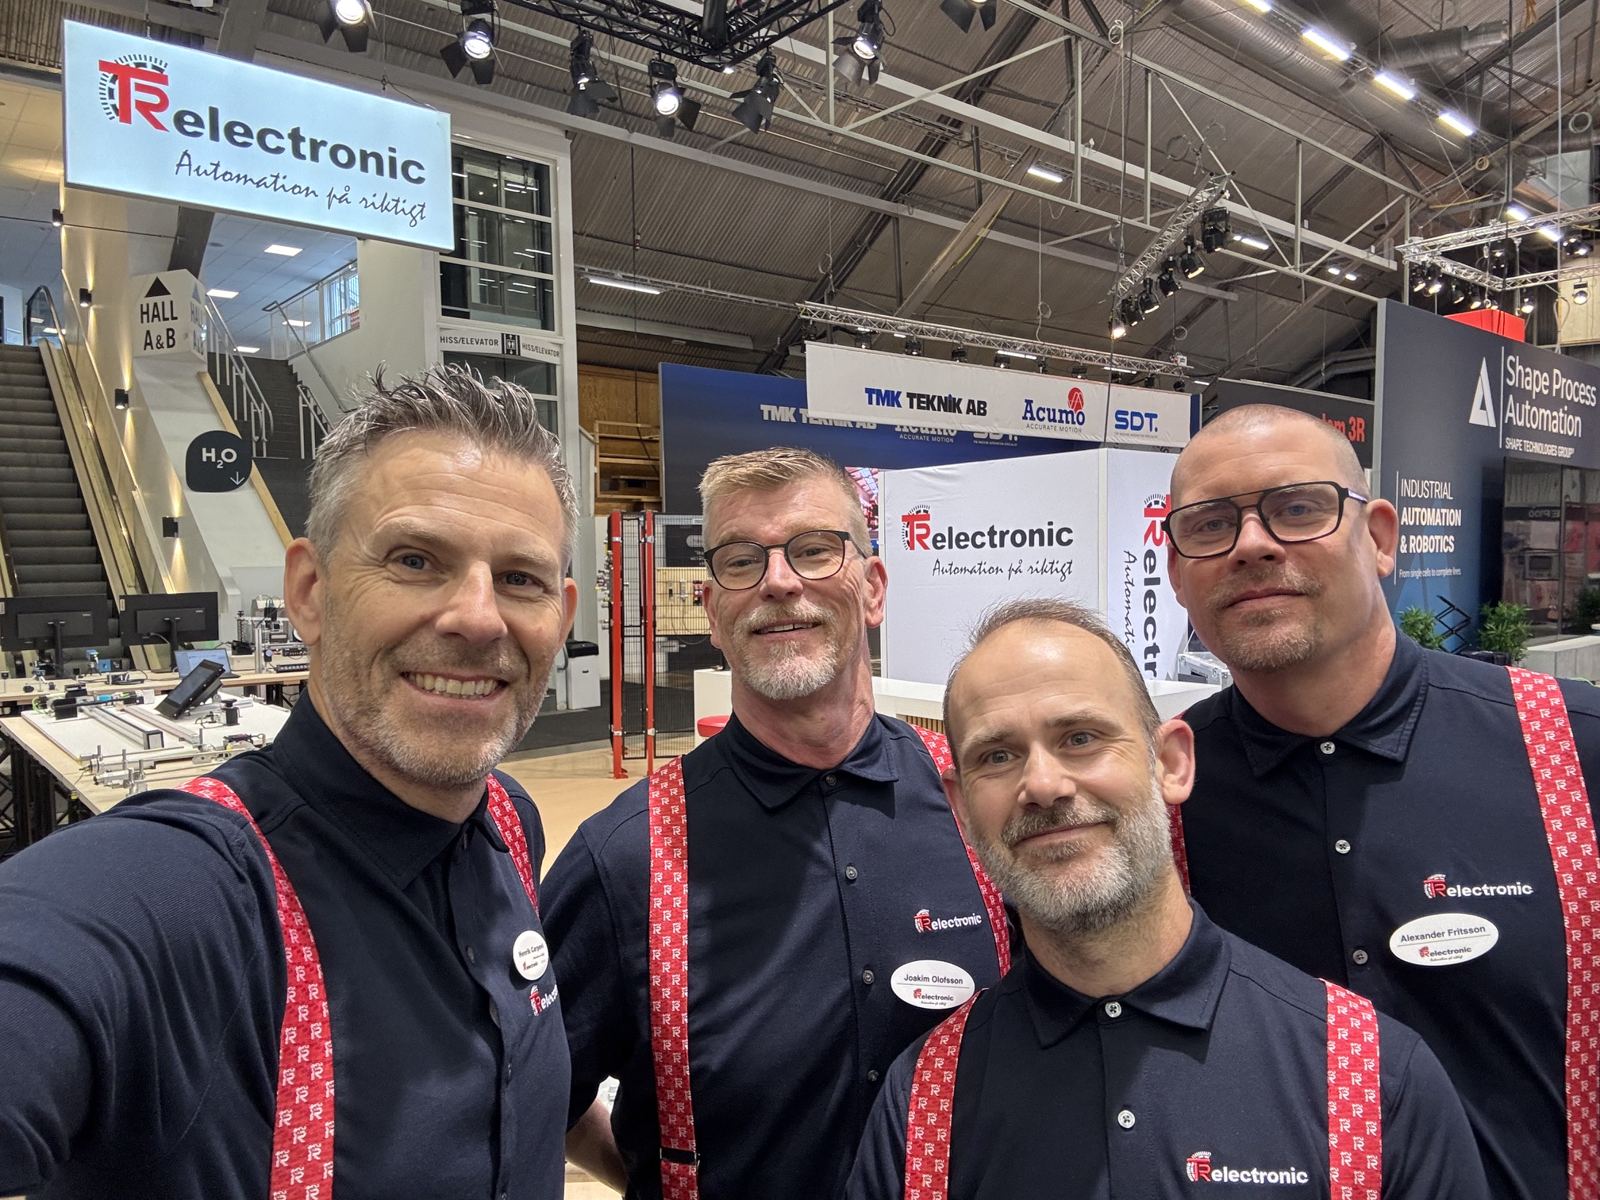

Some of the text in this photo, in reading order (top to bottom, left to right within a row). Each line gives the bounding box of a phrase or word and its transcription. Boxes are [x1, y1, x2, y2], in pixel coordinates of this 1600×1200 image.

[175, 149, 426, 228] Automation på riktigt
[140, 300, 178, 324] HALL
[440, 335, 499, 347] HISS/ELEVATOR
[1506, 355, 1597, 407] Shape Process
[760, 403, 797, 423] TMK
[864, 387, 902, 408] TMK
[965, 399, 988, 417] AB
[1021, 399, 1086, 426] Acumo
[1504, 394, 1582, 438] Automation
[1348, 416, 1366, 442] 3R
[1401, 478, 1454, 500] INDUSTRIAL
[1400, 507, 1462, 527] AUTOMATION
[1399, 534, 1455, 553] & ROBOTICS
[932, 557, 1073, 582] Automation på riktigt
[1400, 925, 1486, 943] Alexander Fritsson
[903, 974, 964, 985] Joakim Olofsson
